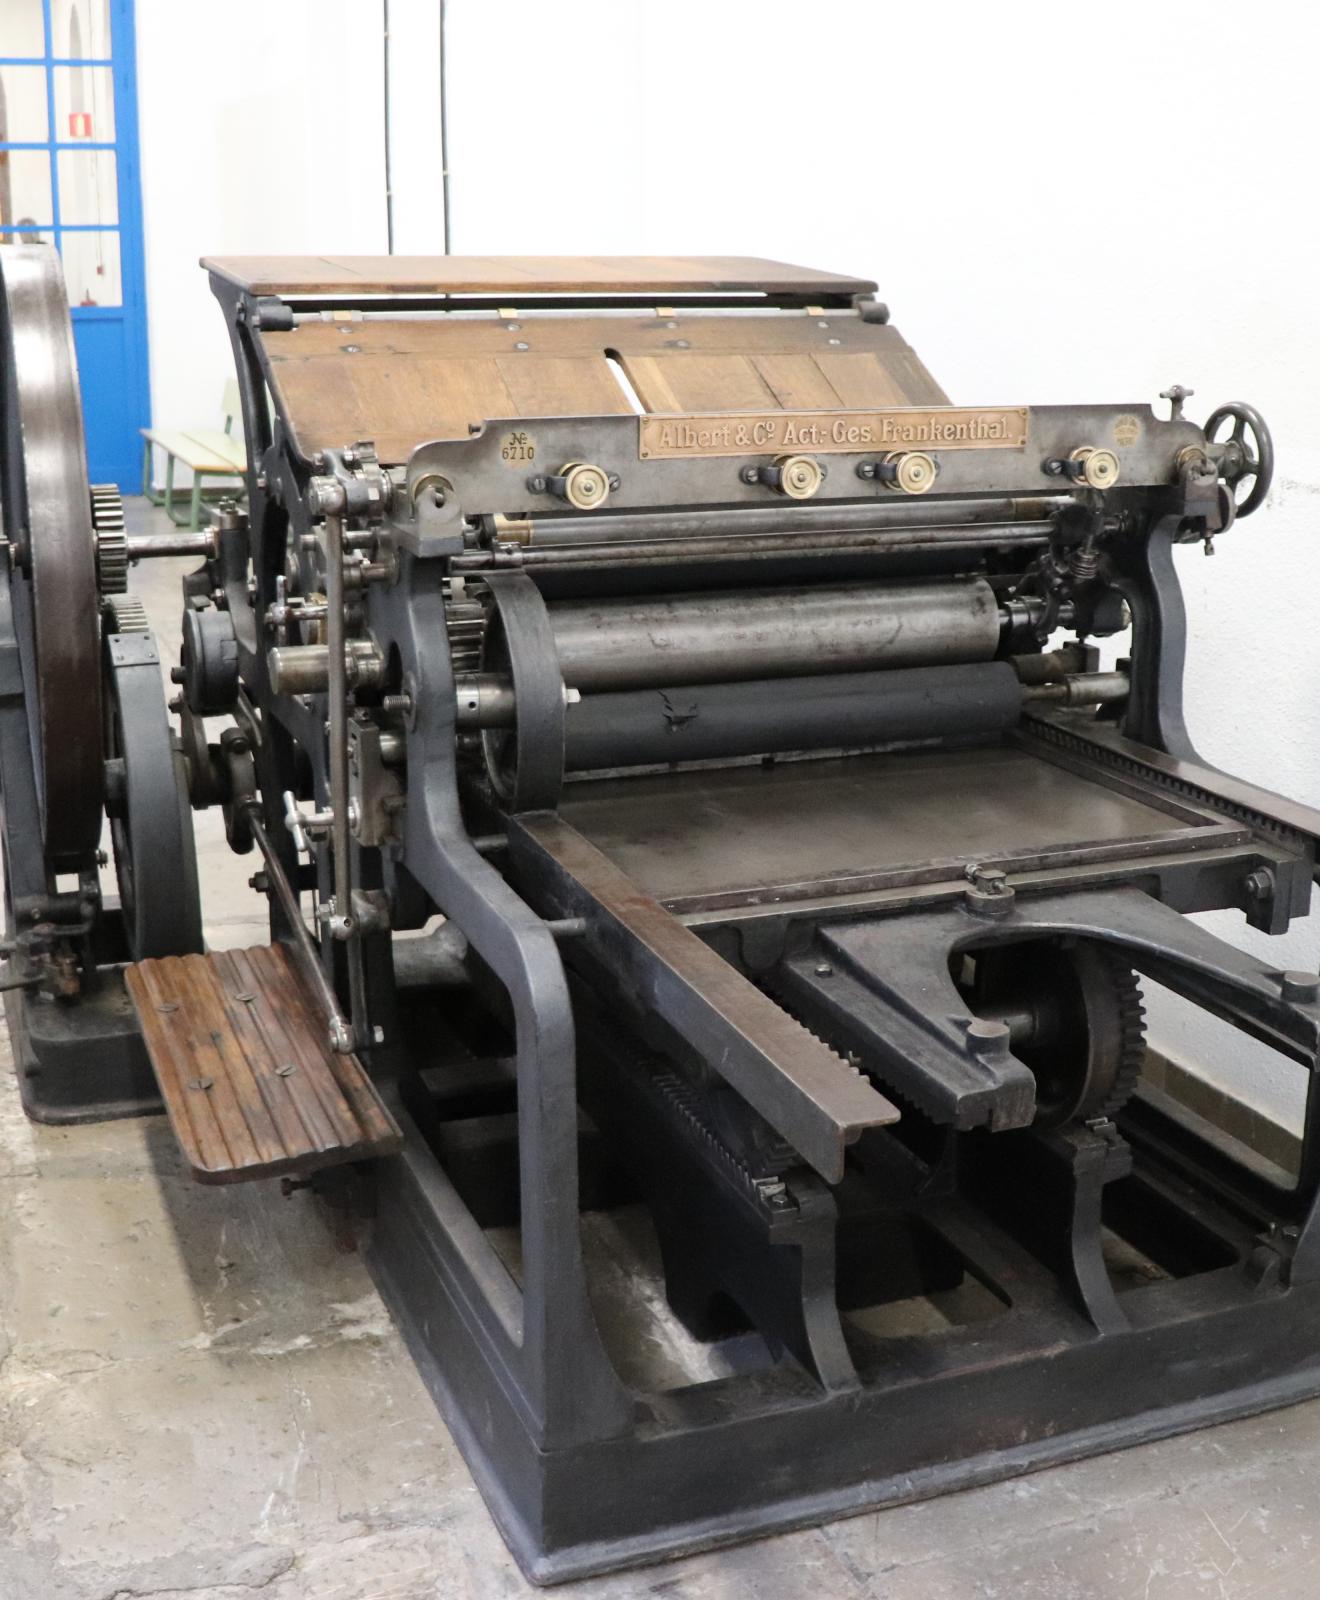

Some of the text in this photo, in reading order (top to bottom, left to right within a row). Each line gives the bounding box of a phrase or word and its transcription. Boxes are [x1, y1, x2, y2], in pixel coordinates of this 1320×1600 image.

[659, 424, 731, 449] Albert
[880, 415, 1013, 443] Frankenthal.
[502, 447, 535, 460] 6710
